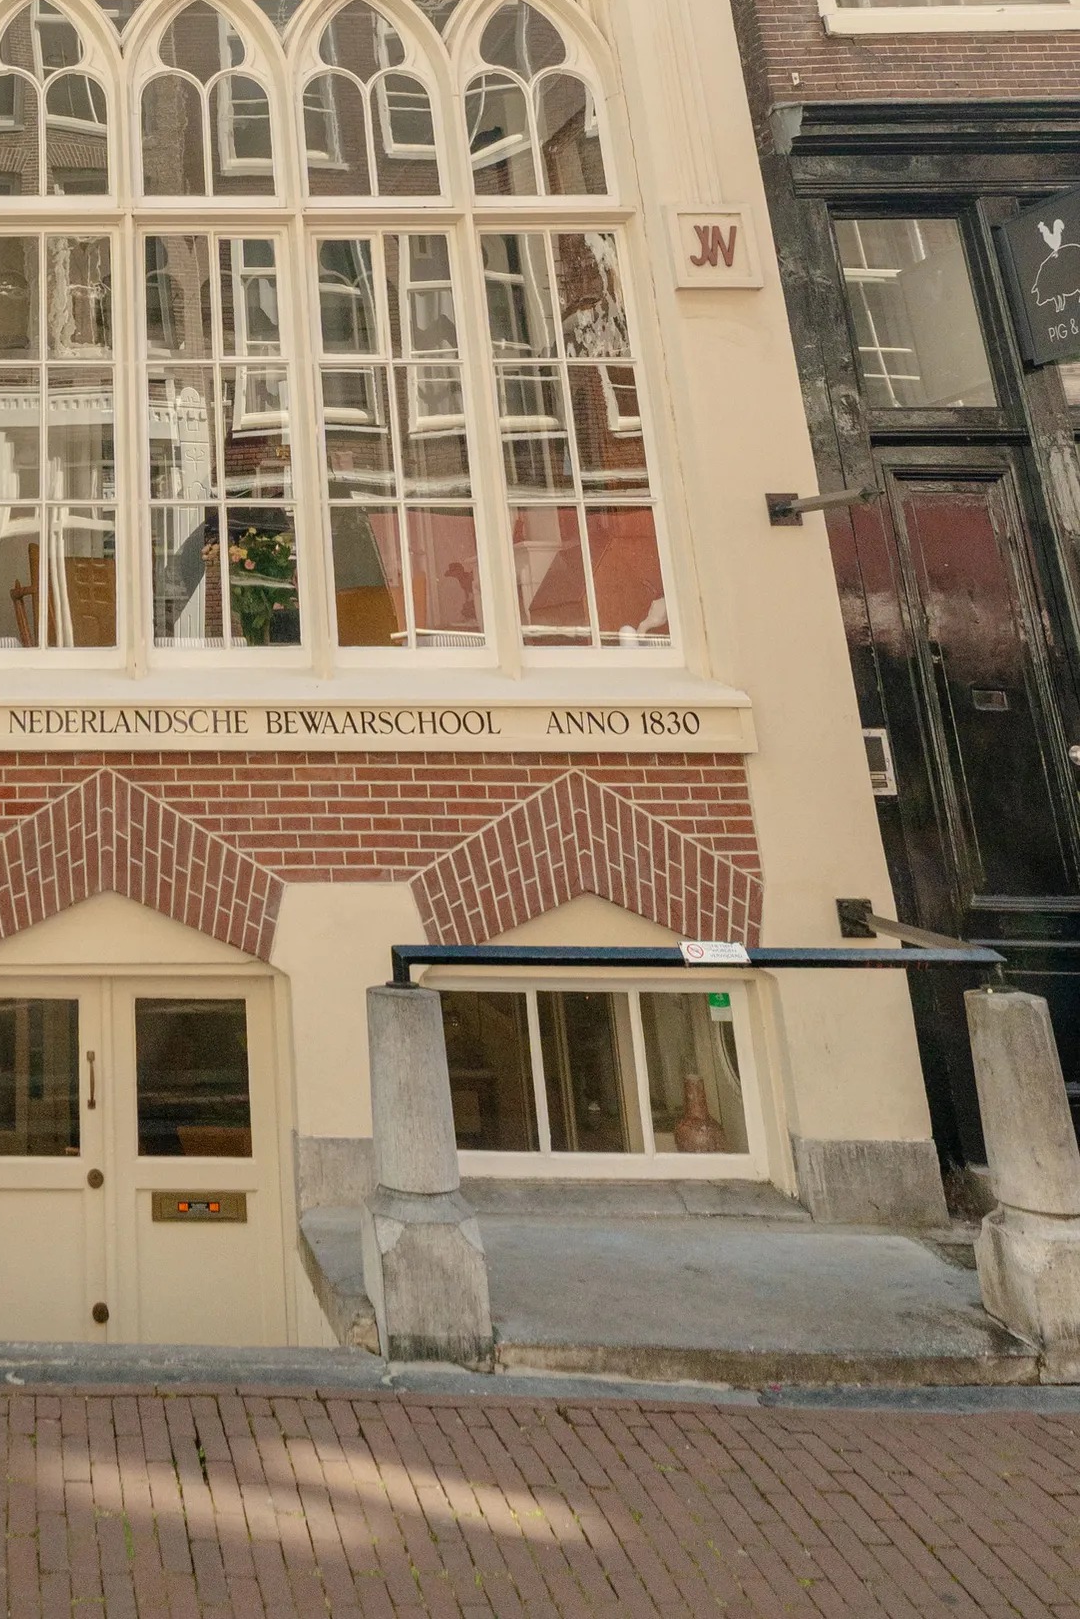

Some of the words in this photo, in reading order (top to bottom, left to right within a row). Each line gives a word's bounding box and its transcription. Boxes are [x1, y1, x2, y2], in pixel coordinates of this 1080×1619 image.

[1048, 323, 1068, 343] PIG
[1070, 318, 1079, 335] &
[8, 709, 249, 735] NEDERLANDSCHE
[265, 709, 502, 735] BEWAARSCHOOL
[546, 710, 630, 735] ANNO
[640, 710, 700, 735] 1830
